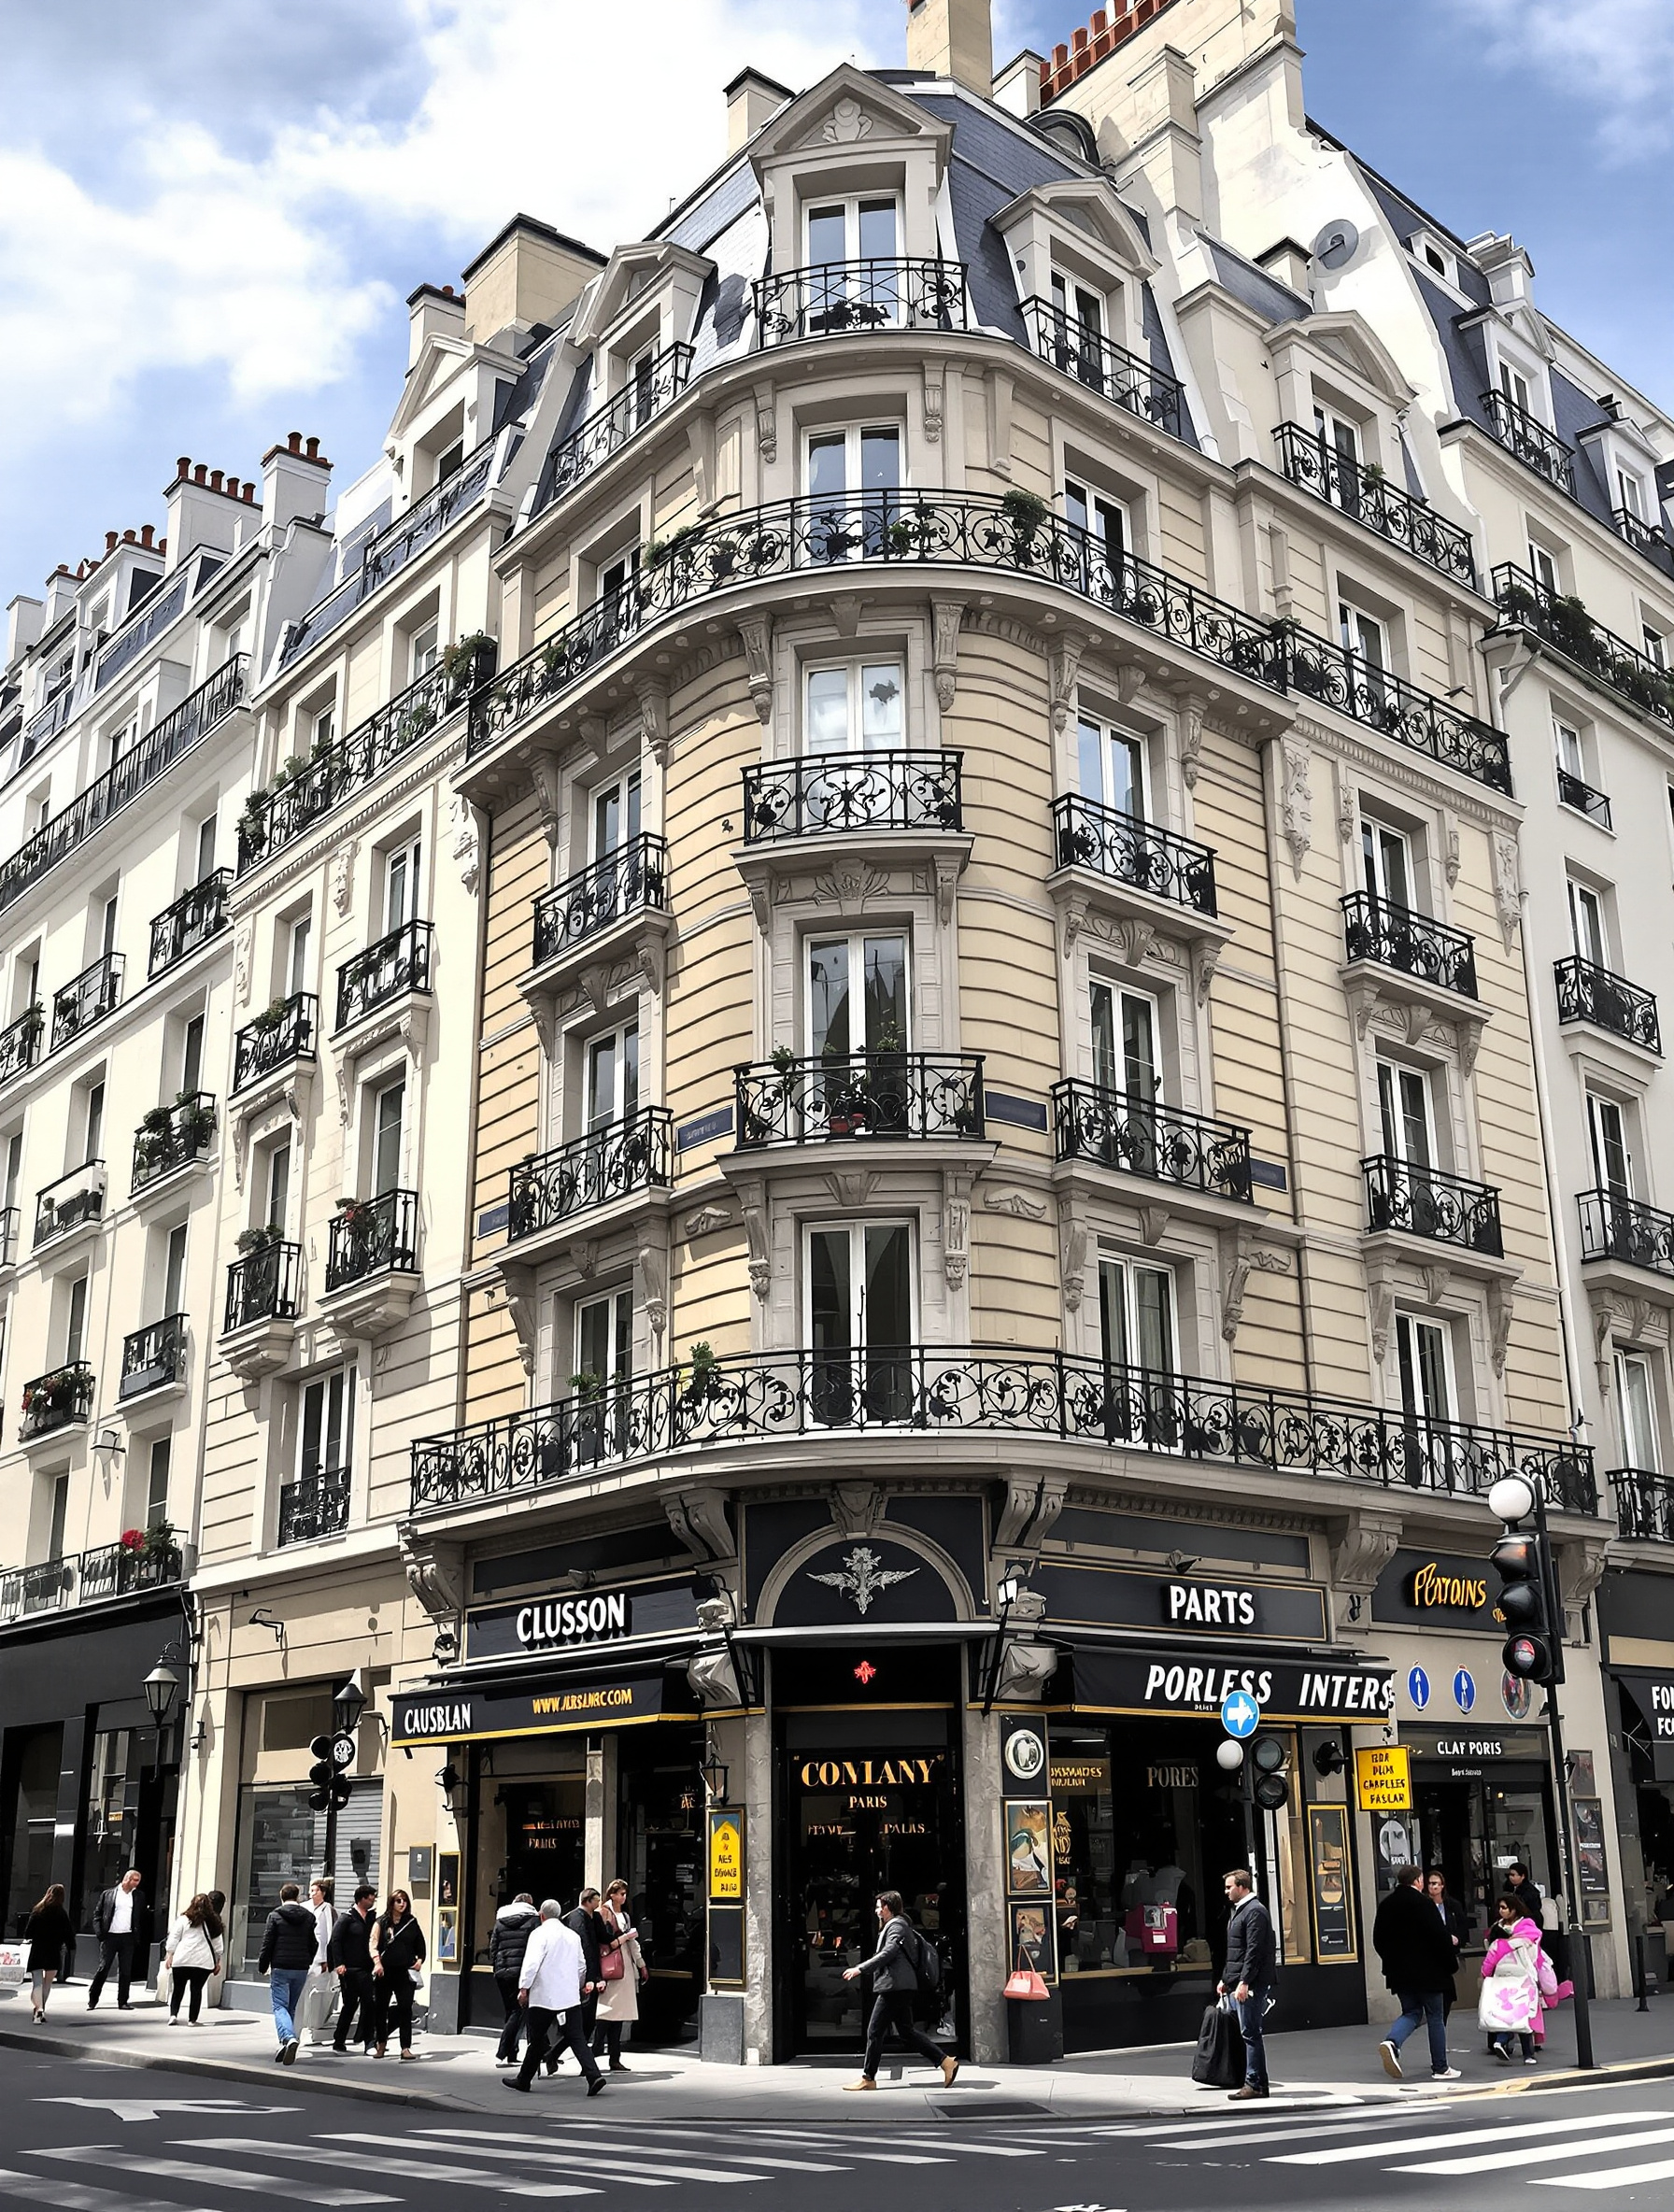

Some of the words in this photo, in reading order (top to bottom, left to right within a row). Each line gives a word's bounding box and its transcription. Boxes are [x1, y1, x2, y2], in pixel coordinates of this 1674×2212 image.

[517, 1593, 626, 1642] CLUSSON
[1170, 1584, 1256, 1625] PARTS
[1144, 1664, 1272, 1705] PORLESS
[404, 1702, 472, 1735] CAUSBLAN
[1468, 1741, 1502, 1755] PORIS
[848, 1795, 887, 1809] PARIS
